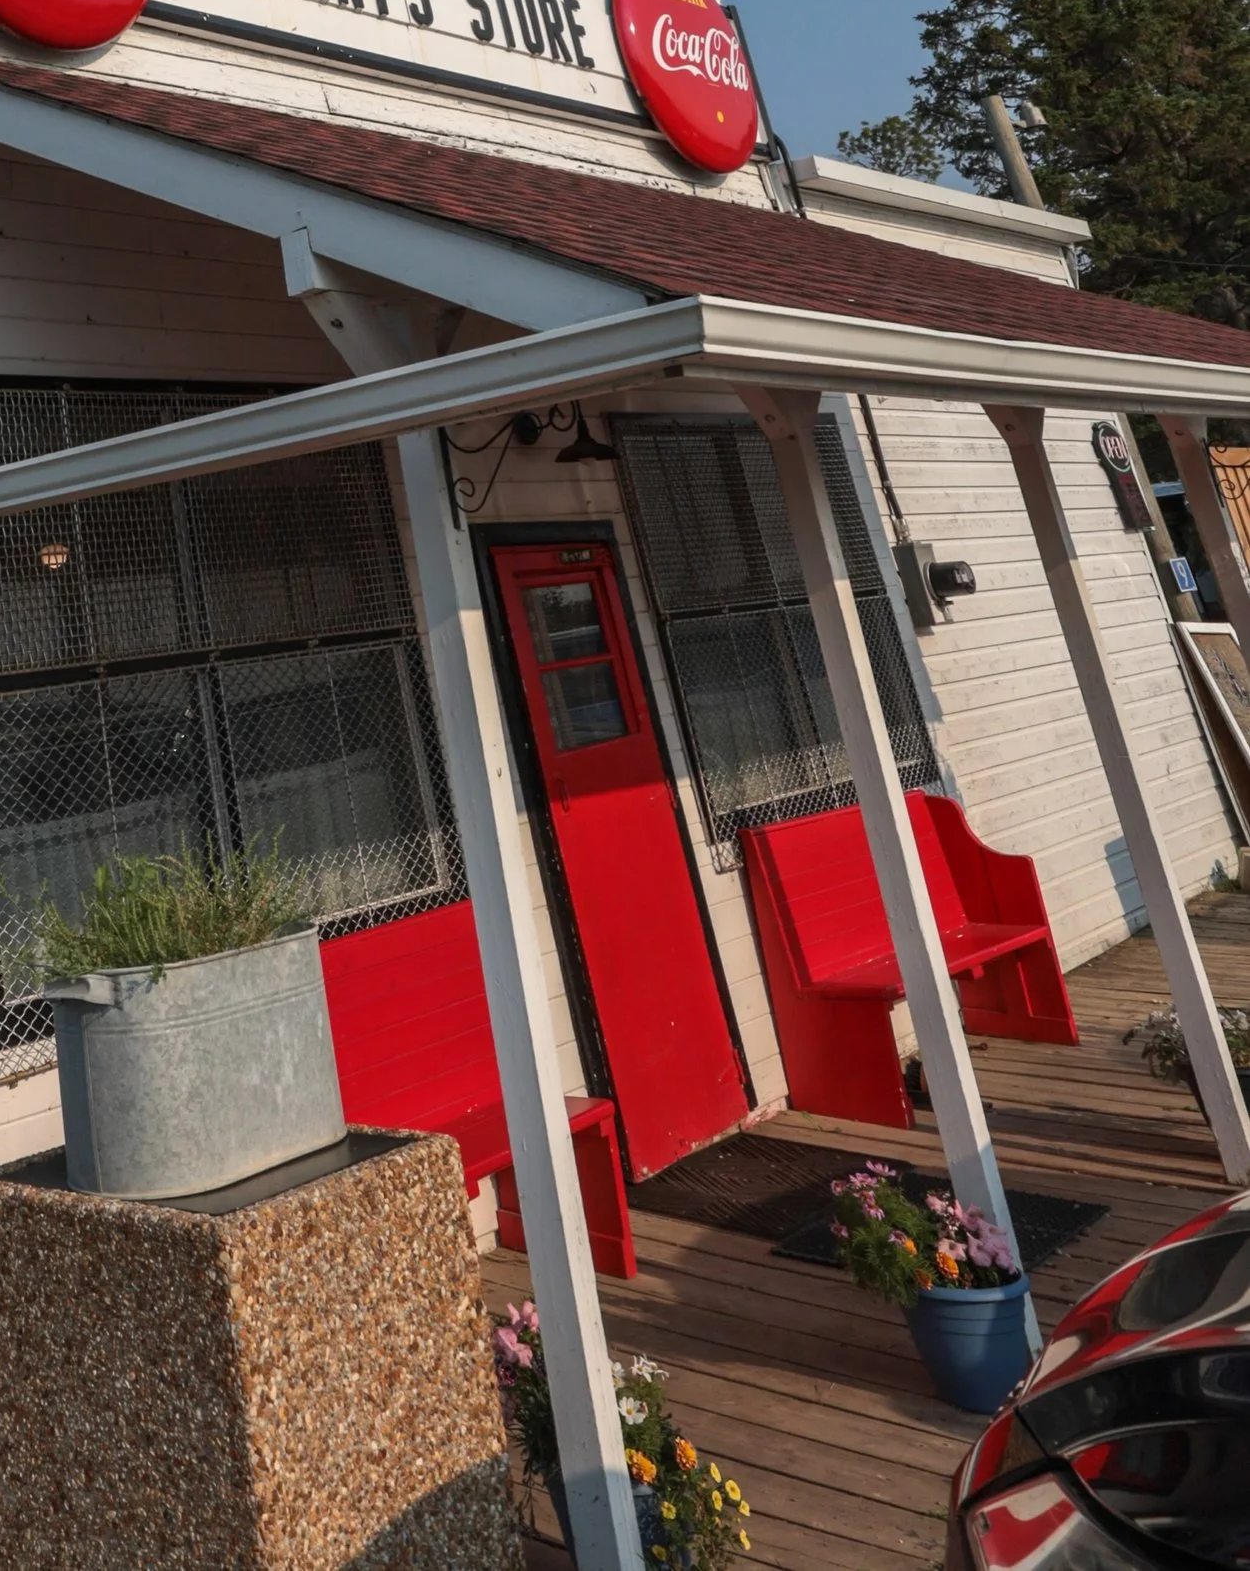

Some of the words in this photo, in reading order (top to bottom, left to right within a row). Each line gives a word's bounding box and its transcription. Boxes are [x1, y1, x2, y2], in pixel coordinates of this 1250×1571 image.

[652, 13, 749, 92] Coca-Cola
[1101, 436, 1129, 459] OPEN
[1176, 561, 1190, 588] 9
